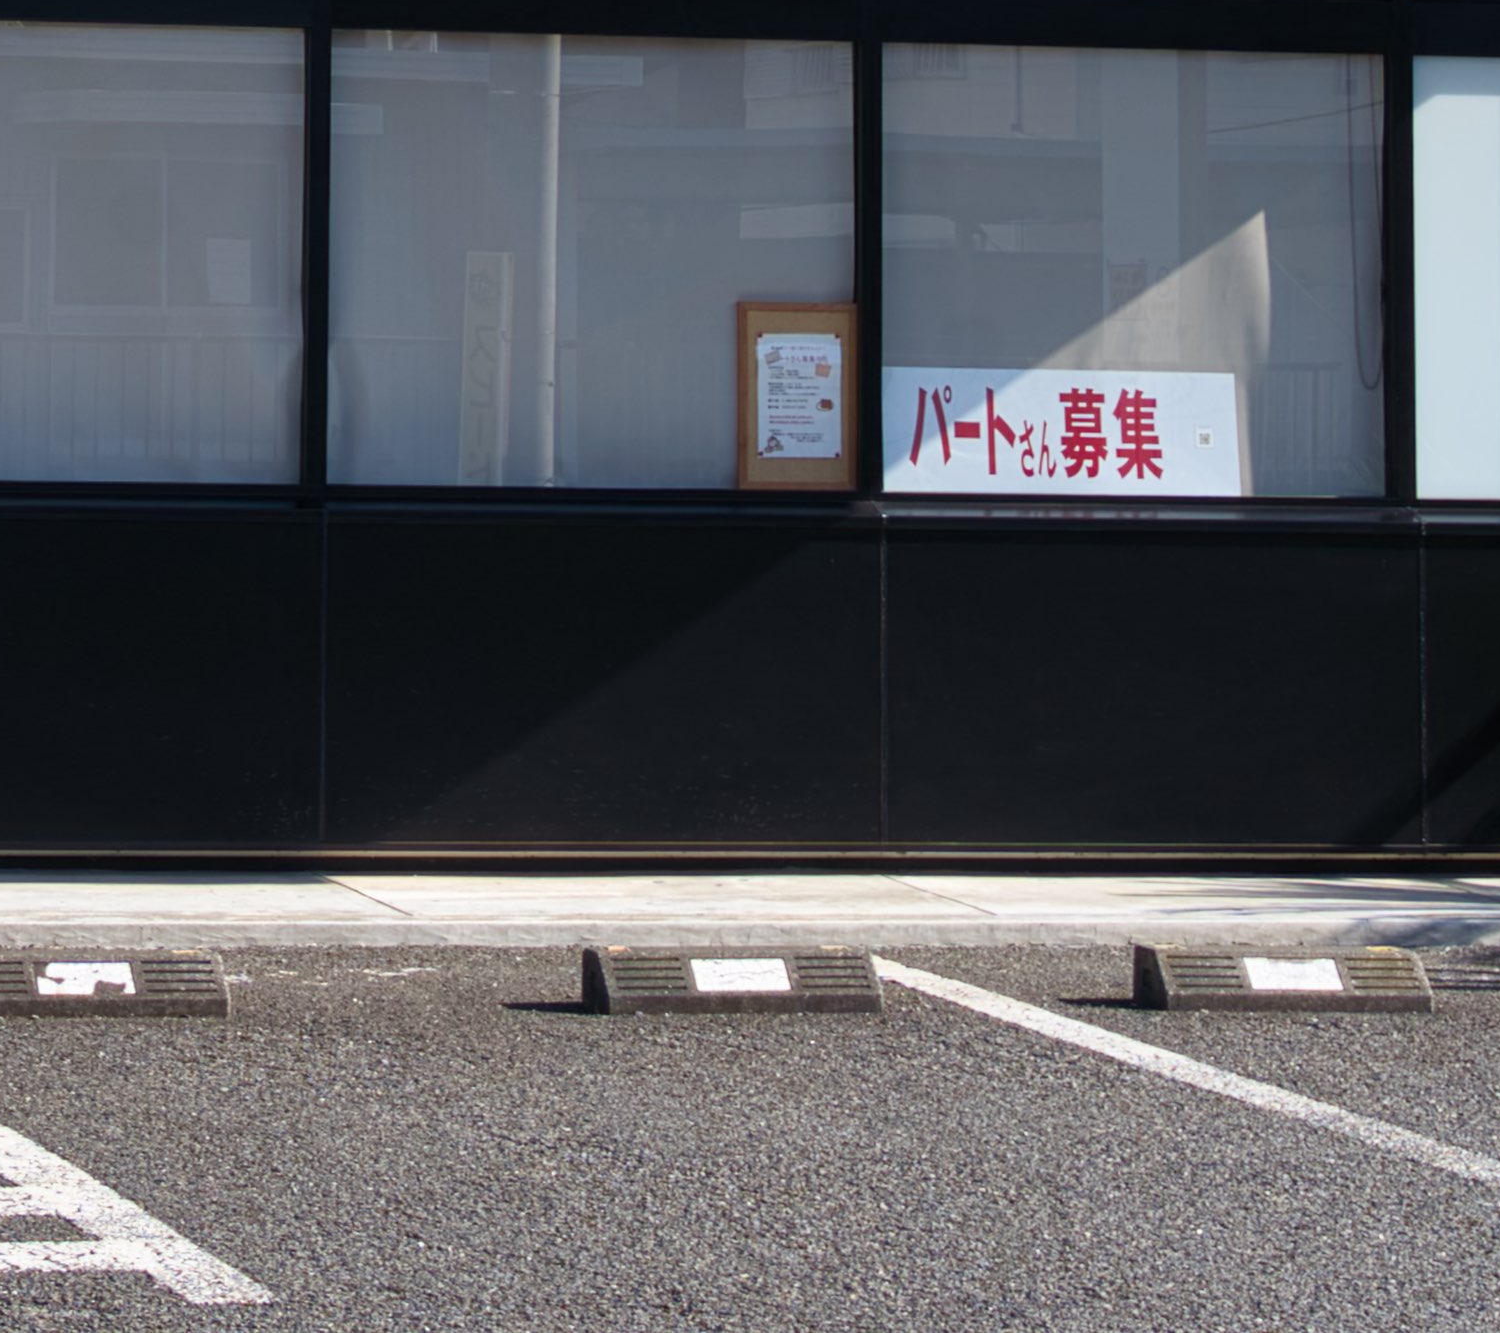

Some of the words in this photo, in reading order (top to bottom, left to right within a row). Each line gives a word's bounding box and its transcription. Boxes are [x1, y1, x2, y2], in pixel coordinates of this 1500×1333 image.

[909, 385, 1163, 480] パートさん募集
